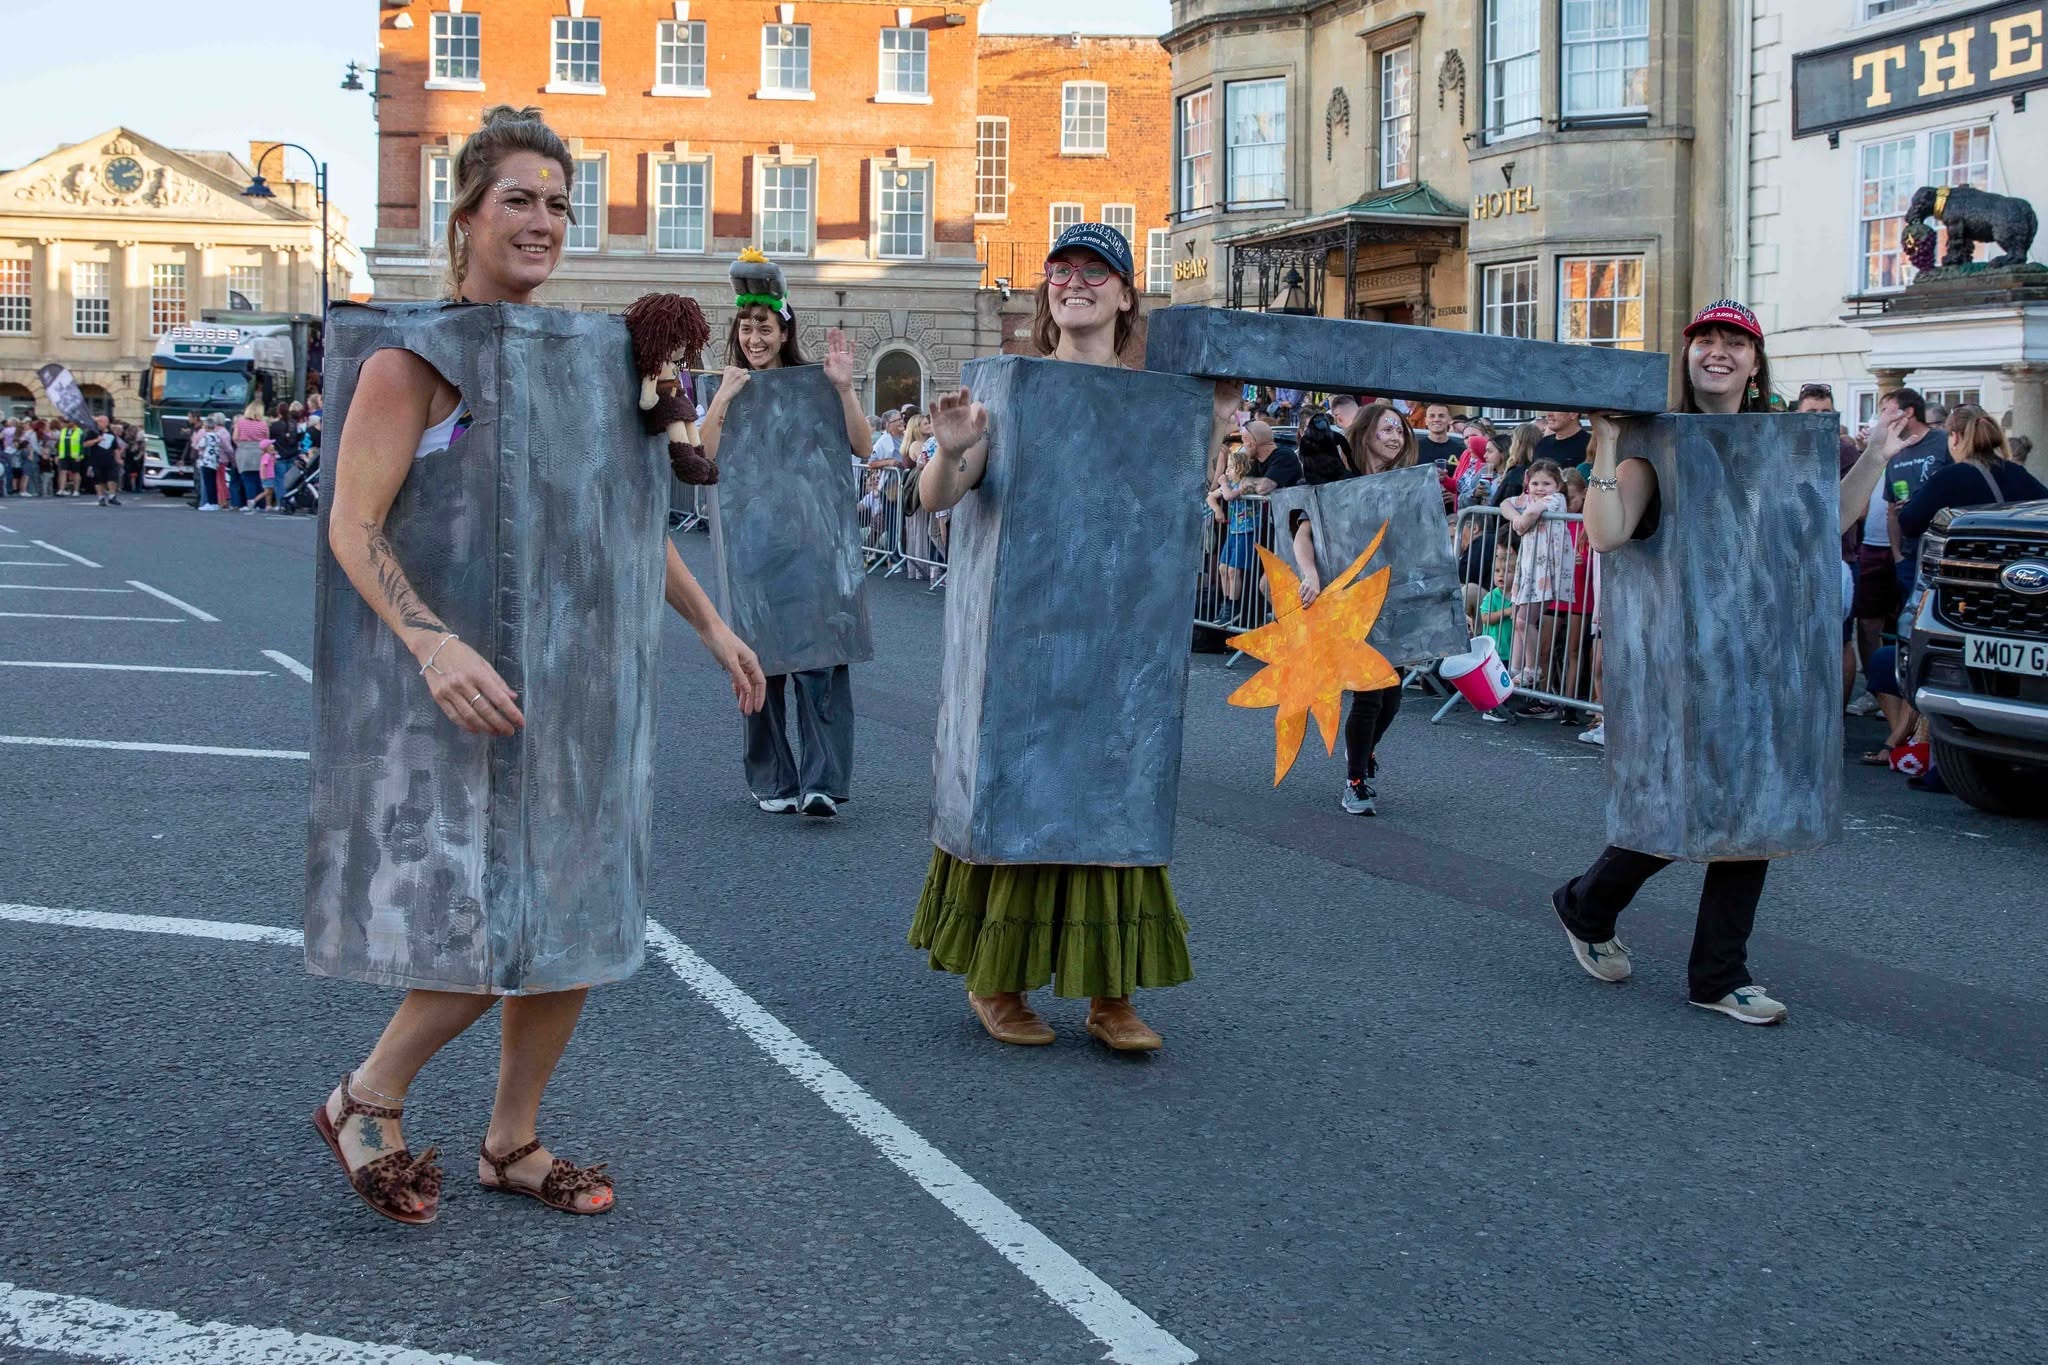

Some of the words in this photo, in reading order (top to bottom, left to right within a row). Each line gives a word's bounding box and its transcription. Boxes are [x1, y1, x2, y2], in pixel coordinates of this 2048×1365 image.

[1852, 9, 2043, 108] THE
[1474, 185, 1539, 220] HOTEL
[1175, 256, 1207, 281] BEAR
[2013, 569, 2043, 586] Ford
[1973, 640, 2025, 668] XM07
[2031, 646, 2048, 671] G
